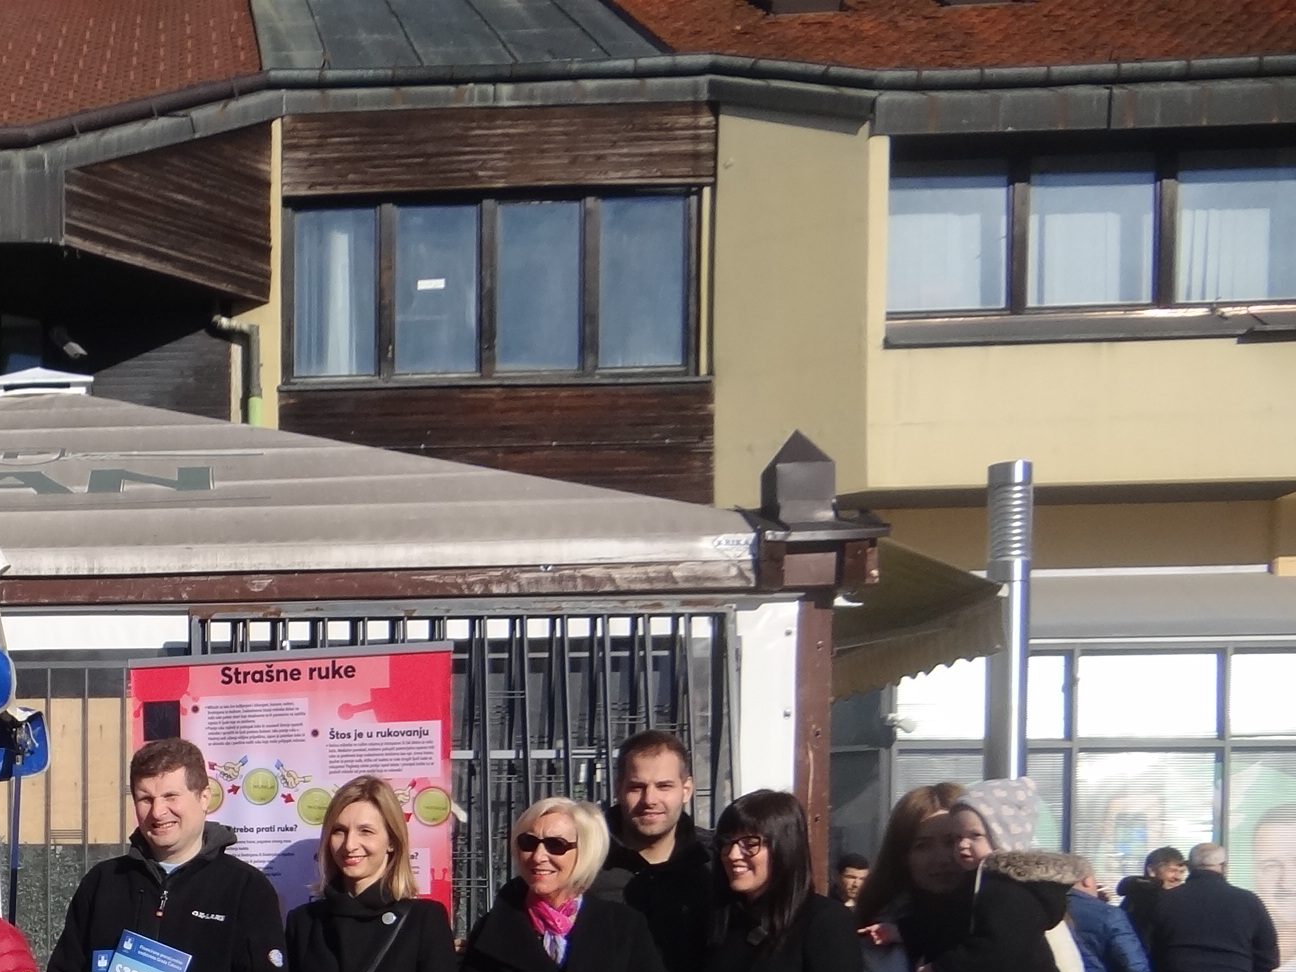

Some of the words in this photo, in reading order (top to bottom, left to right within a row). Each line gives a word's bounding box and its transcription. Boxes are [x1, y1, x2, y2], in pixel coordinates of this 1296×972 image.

[220, 664, 302, 685] Strašne
[308, 659, 356, 680] ruke
[329, 728, 352, 740] Štos
[354, 729, 364, 741] je
[366, 730, 373, 738] u
[376, 727, 429, 739] rukovanju
[256, 825, 275, 834] prati
[277, 824, 298, 832] ruke?
